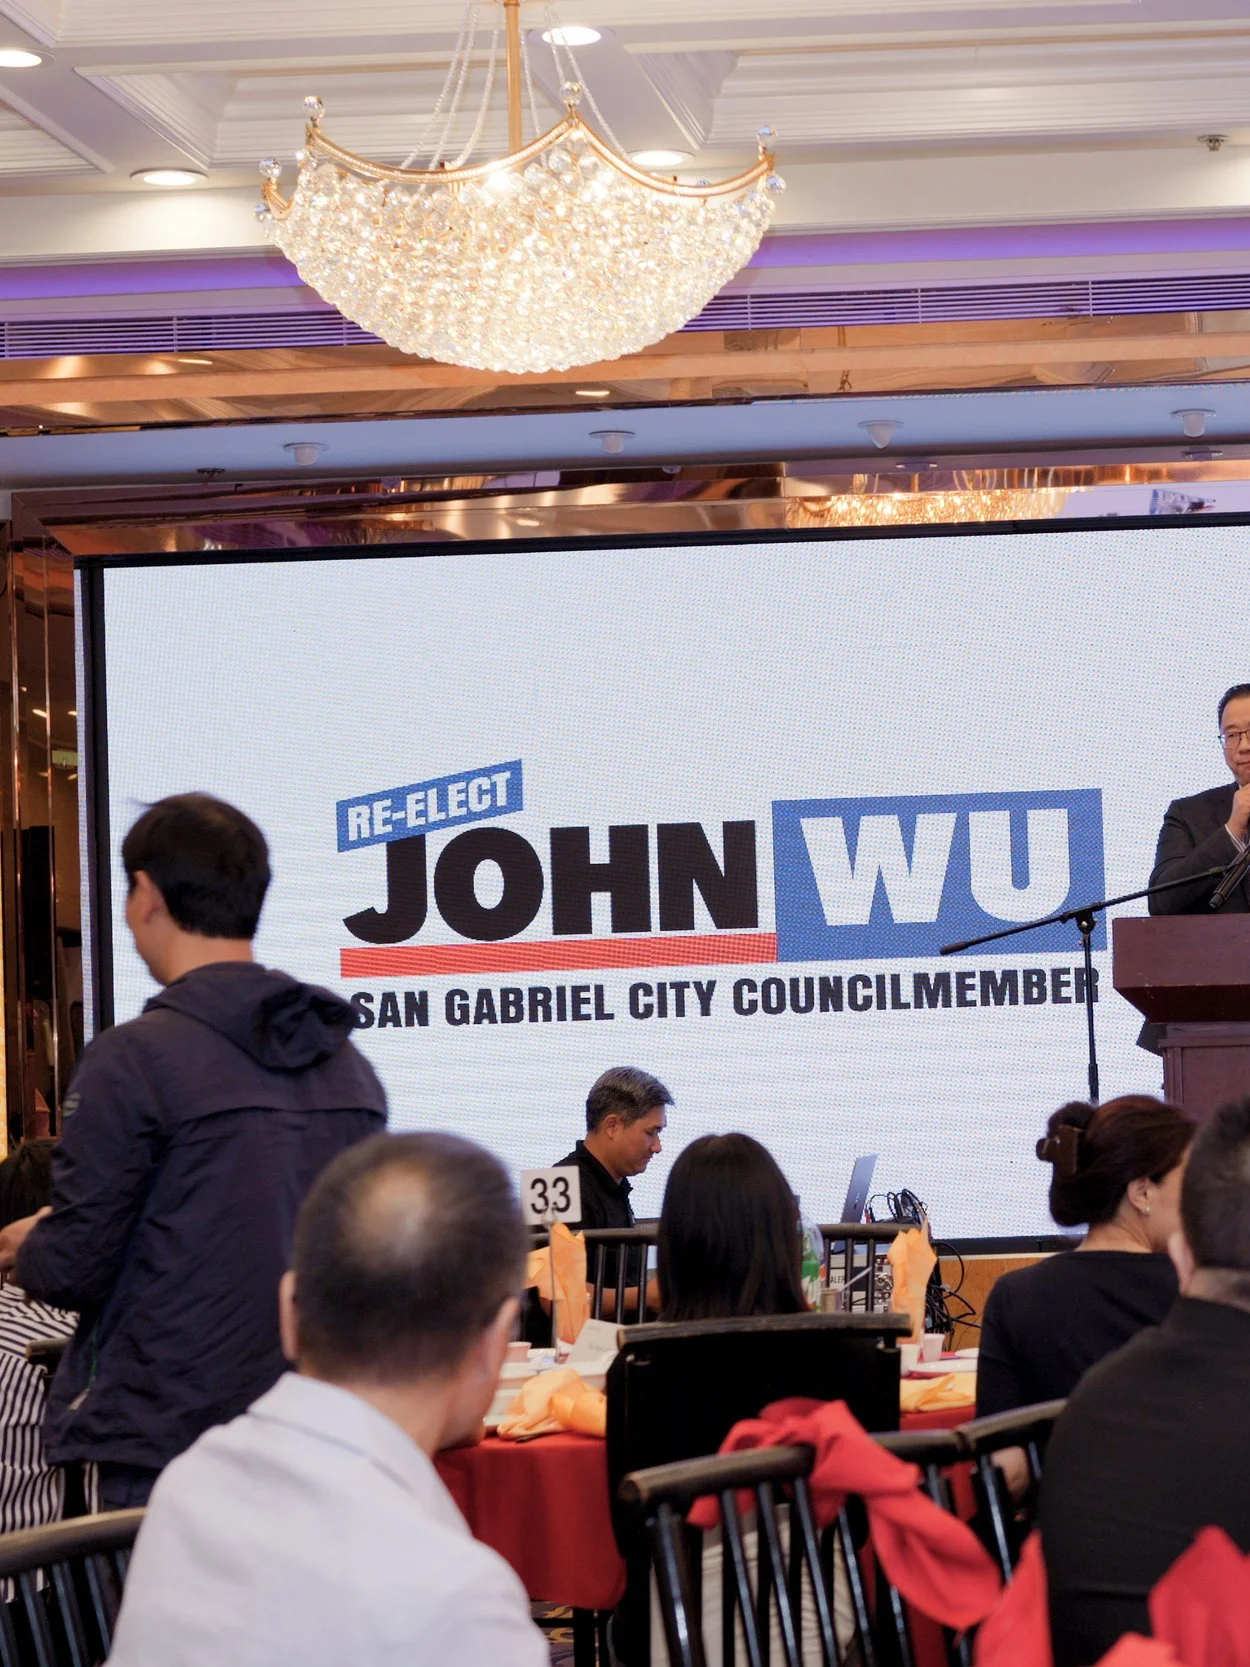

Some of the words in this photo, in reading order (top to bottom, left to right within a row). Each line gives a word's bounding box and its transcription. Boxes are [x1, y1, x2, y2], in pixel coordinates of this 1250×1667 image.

[347, 771, 512, 842] RE-ELECT
[342, 820, 759, 945] JOHN
[799, 807, 1071, 927] WU
[350, 991, 429, 1029] SAN
[445, 984, 614, 1026] GABRIEL
[629, 980, 716, 1020] CITY
[733, 967, 1100, 1016] COUNCILMEMBER
[530, 1176, 571, 1214] 33
